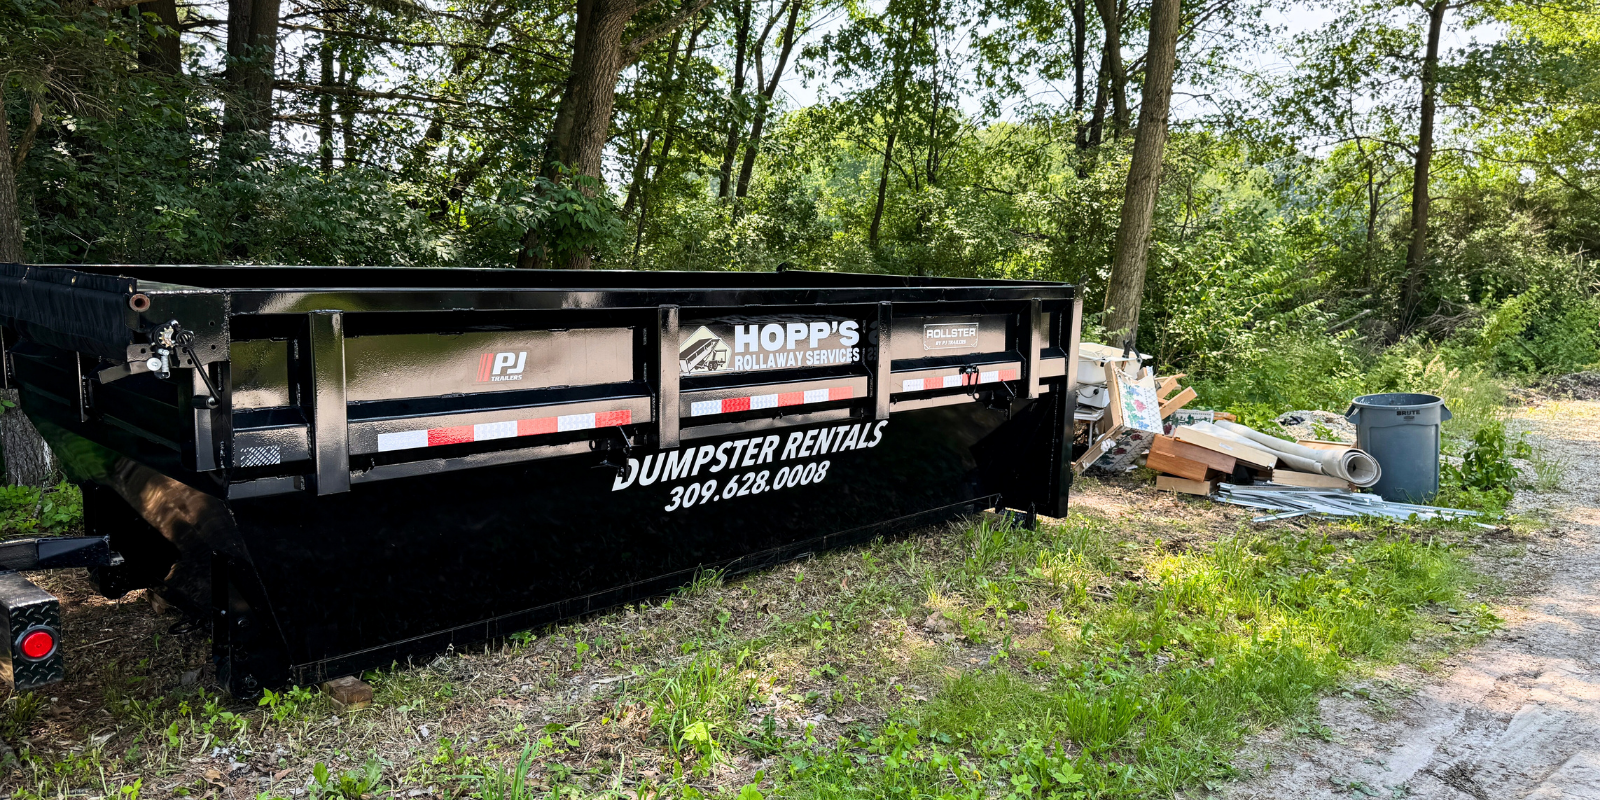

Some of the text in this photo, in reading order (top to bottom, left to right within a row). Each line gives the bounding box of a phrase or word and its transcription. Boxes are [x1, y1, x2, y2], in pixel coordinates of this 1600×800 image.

[734, 320, 860, 353] HOPP'S
[926, 328, 976, 338] ROLLSTER
[492, 351, 527, 375] PJ
[734, 347, 860, 371] ROLLAWAY SERVICES
[611, 420, 888, 491] DUMPSTER RENTALS
[664, 460, 831, 512] 309.628.0008
